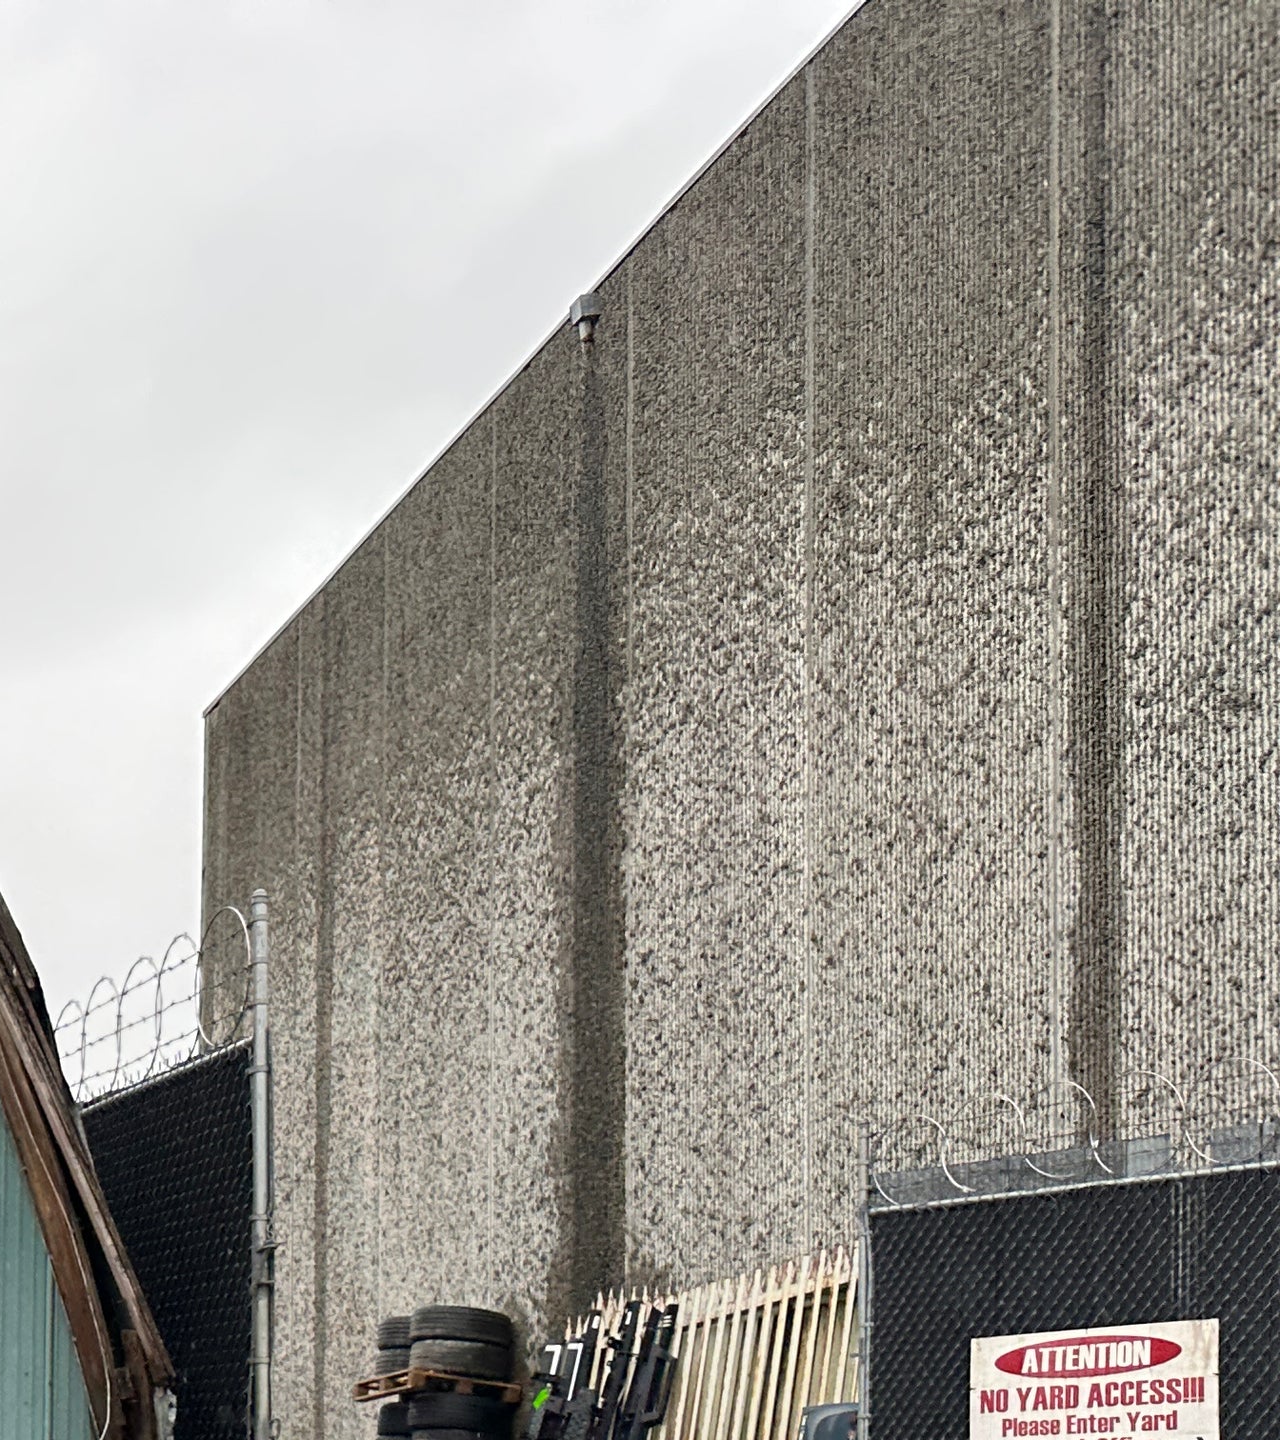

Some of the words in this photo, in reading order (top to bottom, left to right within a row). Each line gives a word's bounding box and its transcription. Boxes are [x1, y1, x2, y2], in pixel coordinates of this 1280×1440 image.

[1021, 1339, 1151, 1374] ATTENTION
[980, 1388, 1009, 1414] NO
[1016, 1384, 1080, 1412] YARD
[1087, 1376, 1206, 1409] ACCESS!!!
[1002, 1418, 1061, 1438] Please
[1066, 1414, 1121, 1435] Enter
[1127, 1410, 1178, 1432] Yard
